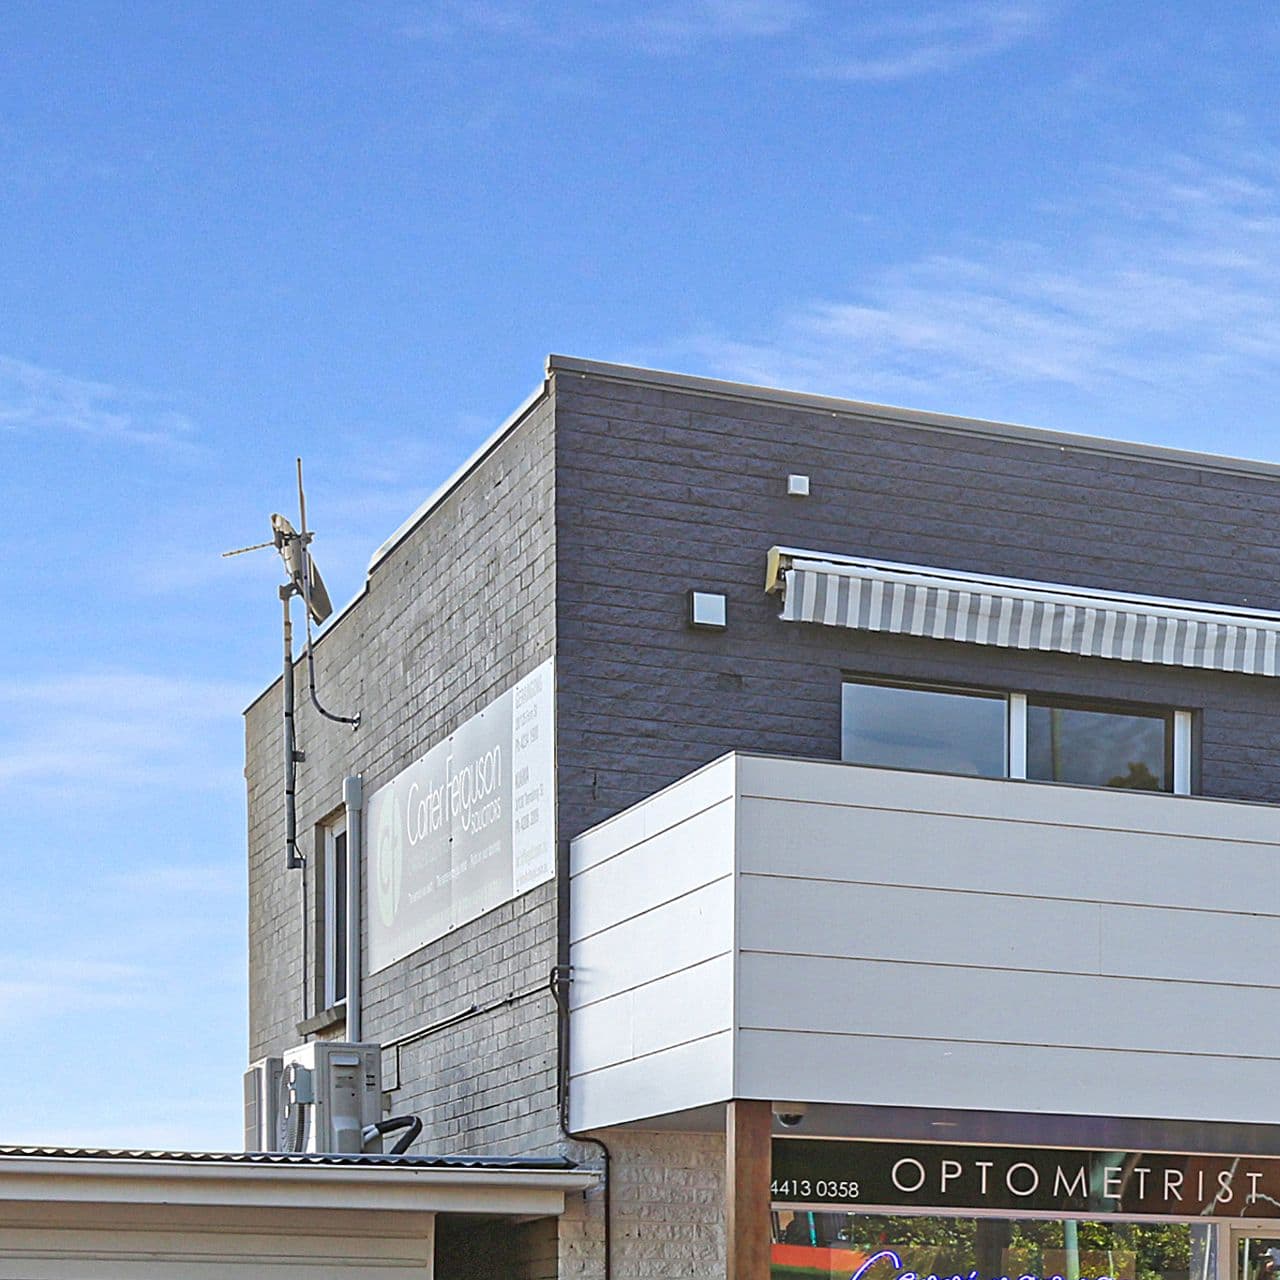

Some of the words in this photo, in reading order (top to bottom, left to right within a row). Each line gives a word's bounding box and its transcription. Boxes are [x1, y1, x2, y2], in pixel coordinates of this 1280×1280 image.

[407, 781, 444, 846] Carter
[446, 744, 502, 832] Ferguson
[770, 1179, 812, 1197] 4413
[815, 1180, 860, 1198] 0358
[891, 1157, 1264, 1205] OPTOMETRIST
